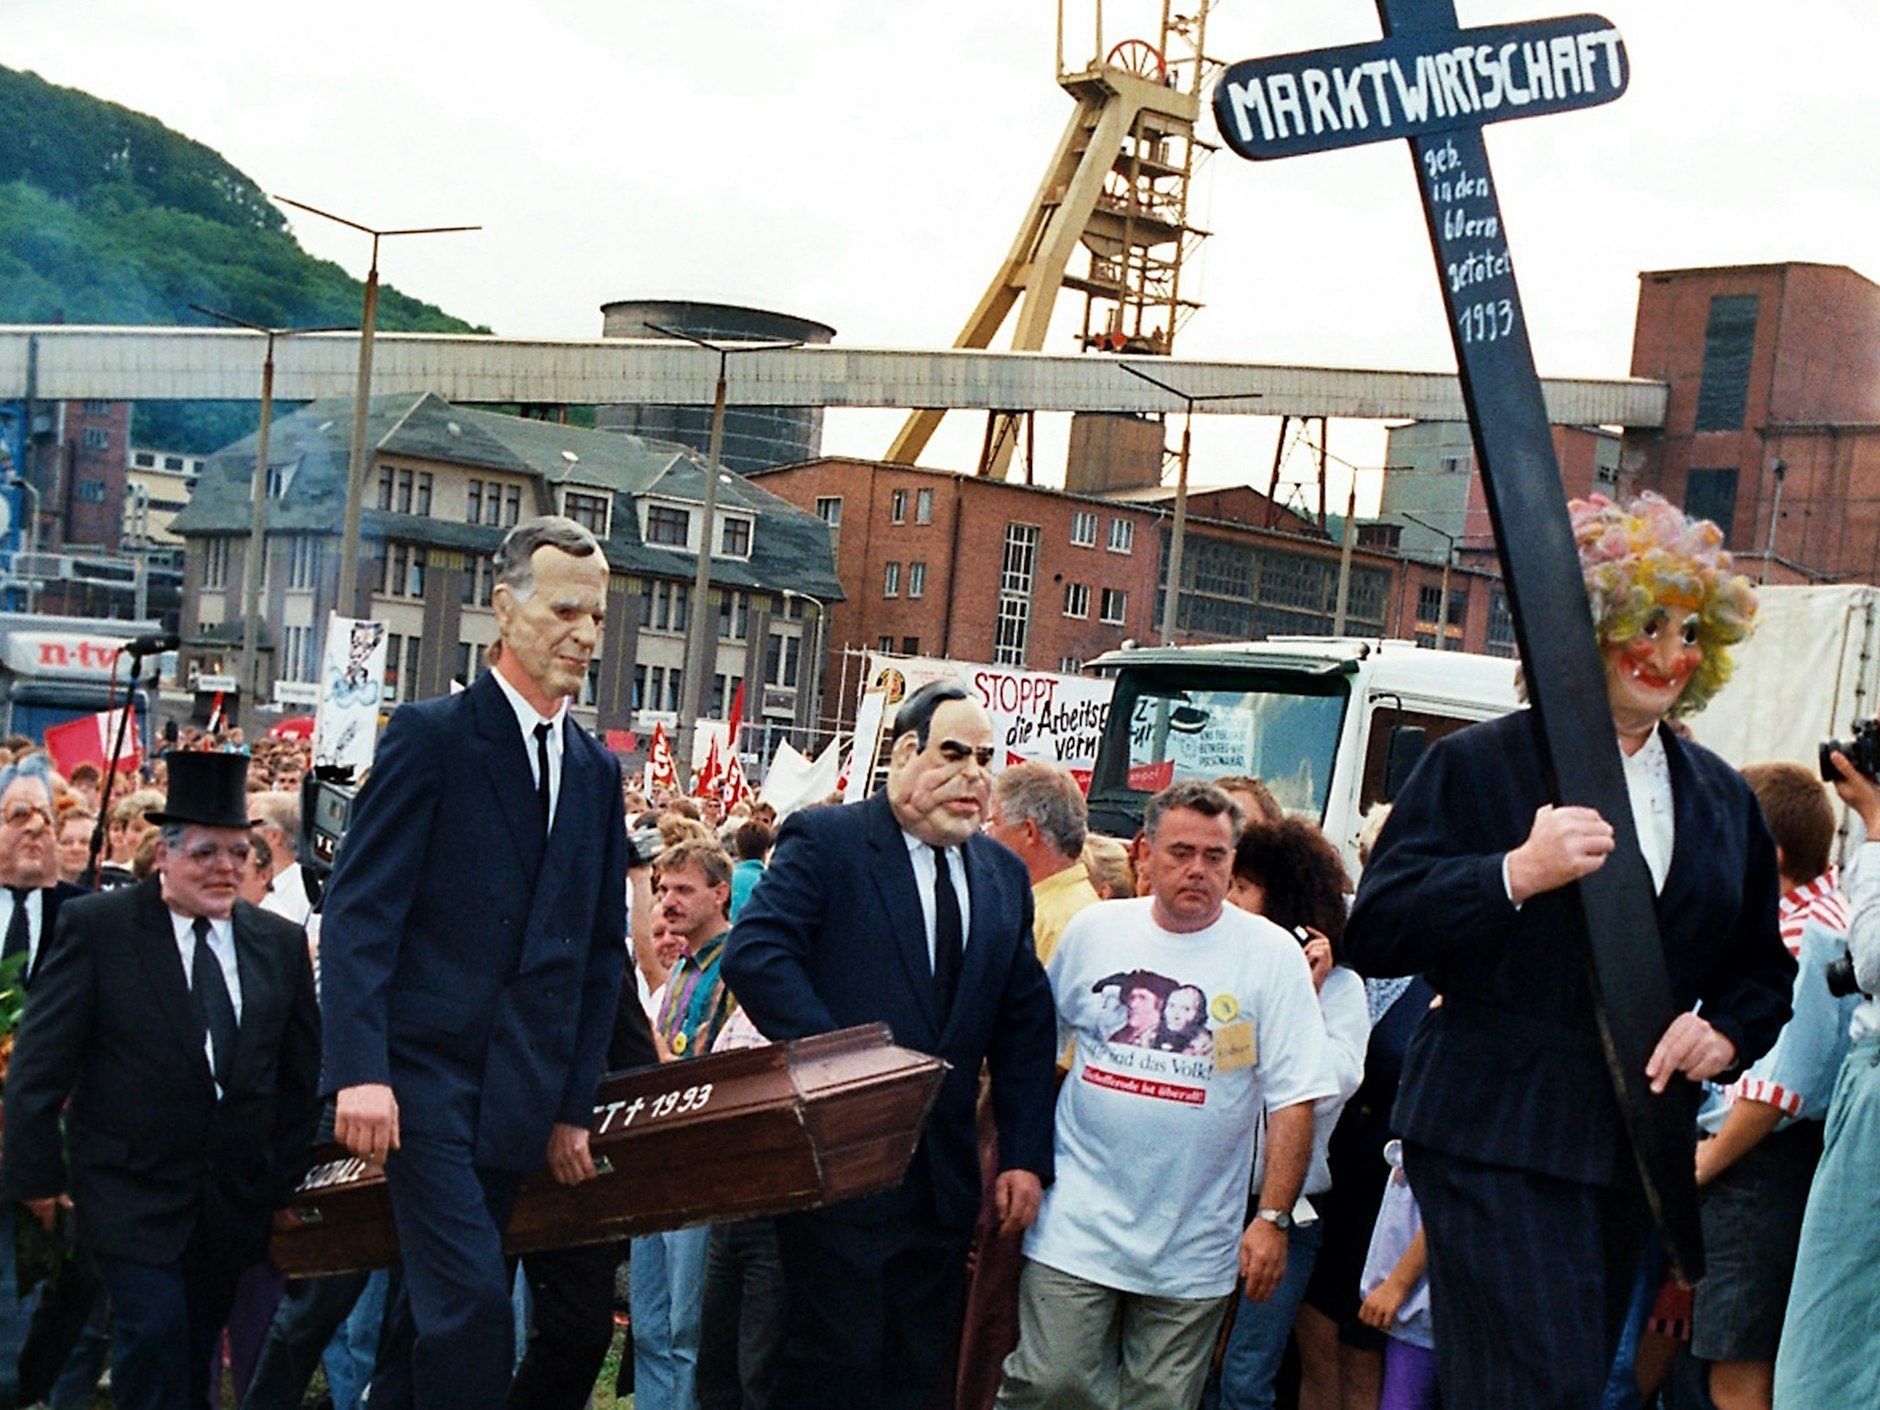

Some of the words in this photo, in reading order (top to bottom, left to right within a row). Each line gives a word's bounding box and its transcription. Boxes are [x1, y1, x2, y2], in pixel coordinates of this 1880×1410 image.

[1228, 29, 1622, 142] MARKTWIRTSCHAFT
[1425, 139, 1461, 177] geb.
[1433, 176, 1452, 202] in
[1454, 171, 1488, 198] den
[1459, 299, 1514, 343] 1993
[974, 671, 1060, 716] STOPPT
[1006, 715, 1034, 748] die
[1140, 1054, 1166, 1072] das
[1172, 1058, 1214, 1081] Volk!
[651, 1083, 713, 1118] 1993
